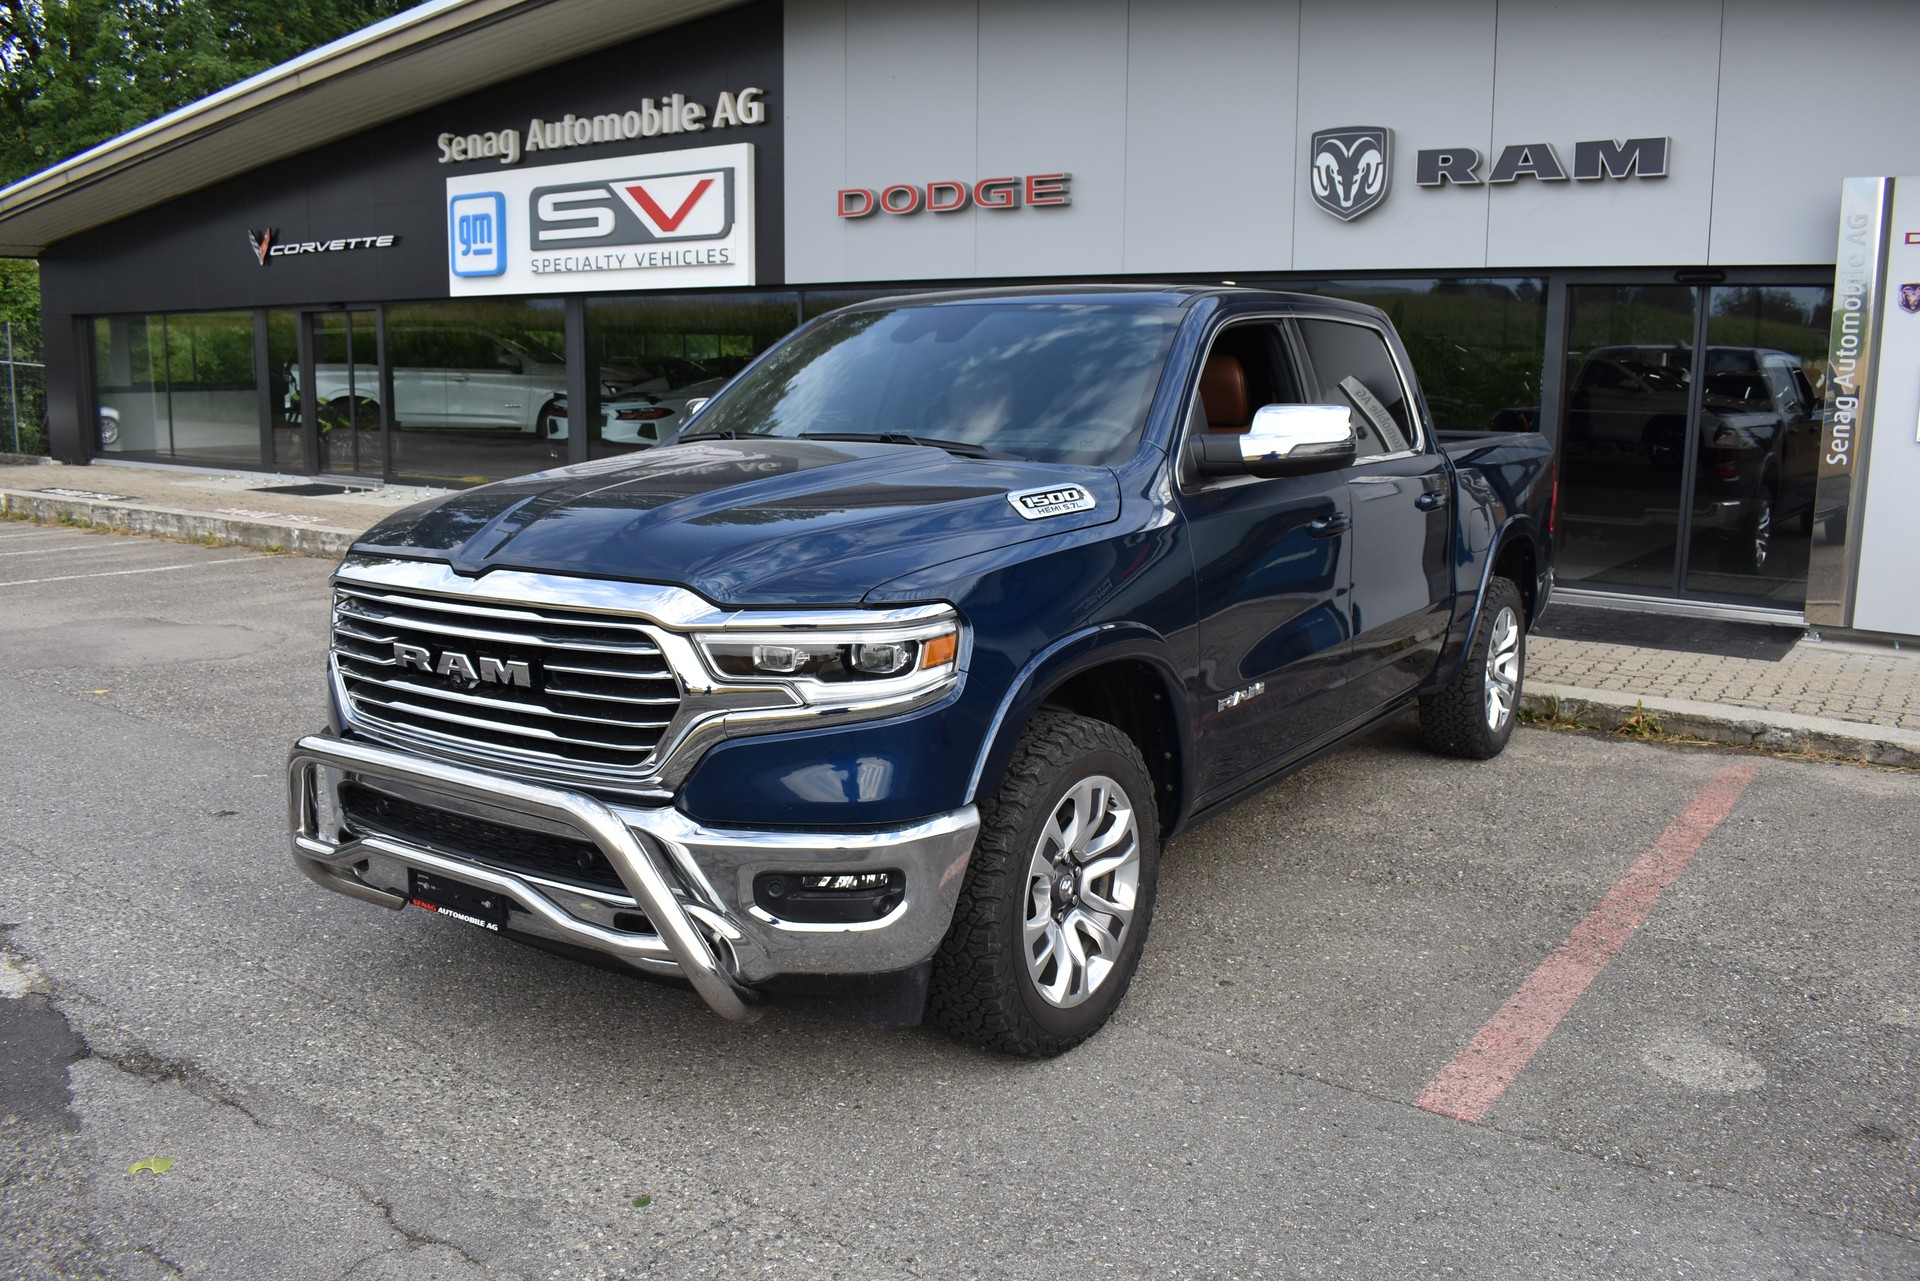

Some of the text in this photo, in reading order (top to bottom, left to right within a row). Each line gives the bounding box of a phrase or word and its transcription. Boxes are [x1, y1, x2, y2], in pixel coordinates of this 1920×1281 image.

[438, 87, 765, 163] Senag Automobile AG
[1416, 136, 1672, 186] RAM
[838, 172, 1072, 217] DODGE
[270, 235, 394, 256] CORVETTE
[459, 212, 492, 256] gm
[531, 247, 730, 273] SPECIALTY VEHICLES
[1826, 213, 1869, 466] Senag Automobile AG
[1021, 489, 1080, 508] 1500
[1037, 502, 1083, 515] HEMI 5.7L
[393, 642, 531, 688] RAM
[1218, 682, 1265, 712] RAM
[438, 907, 485, 927] AUTOMOBILE
[486, 922, 498, 931] AG
